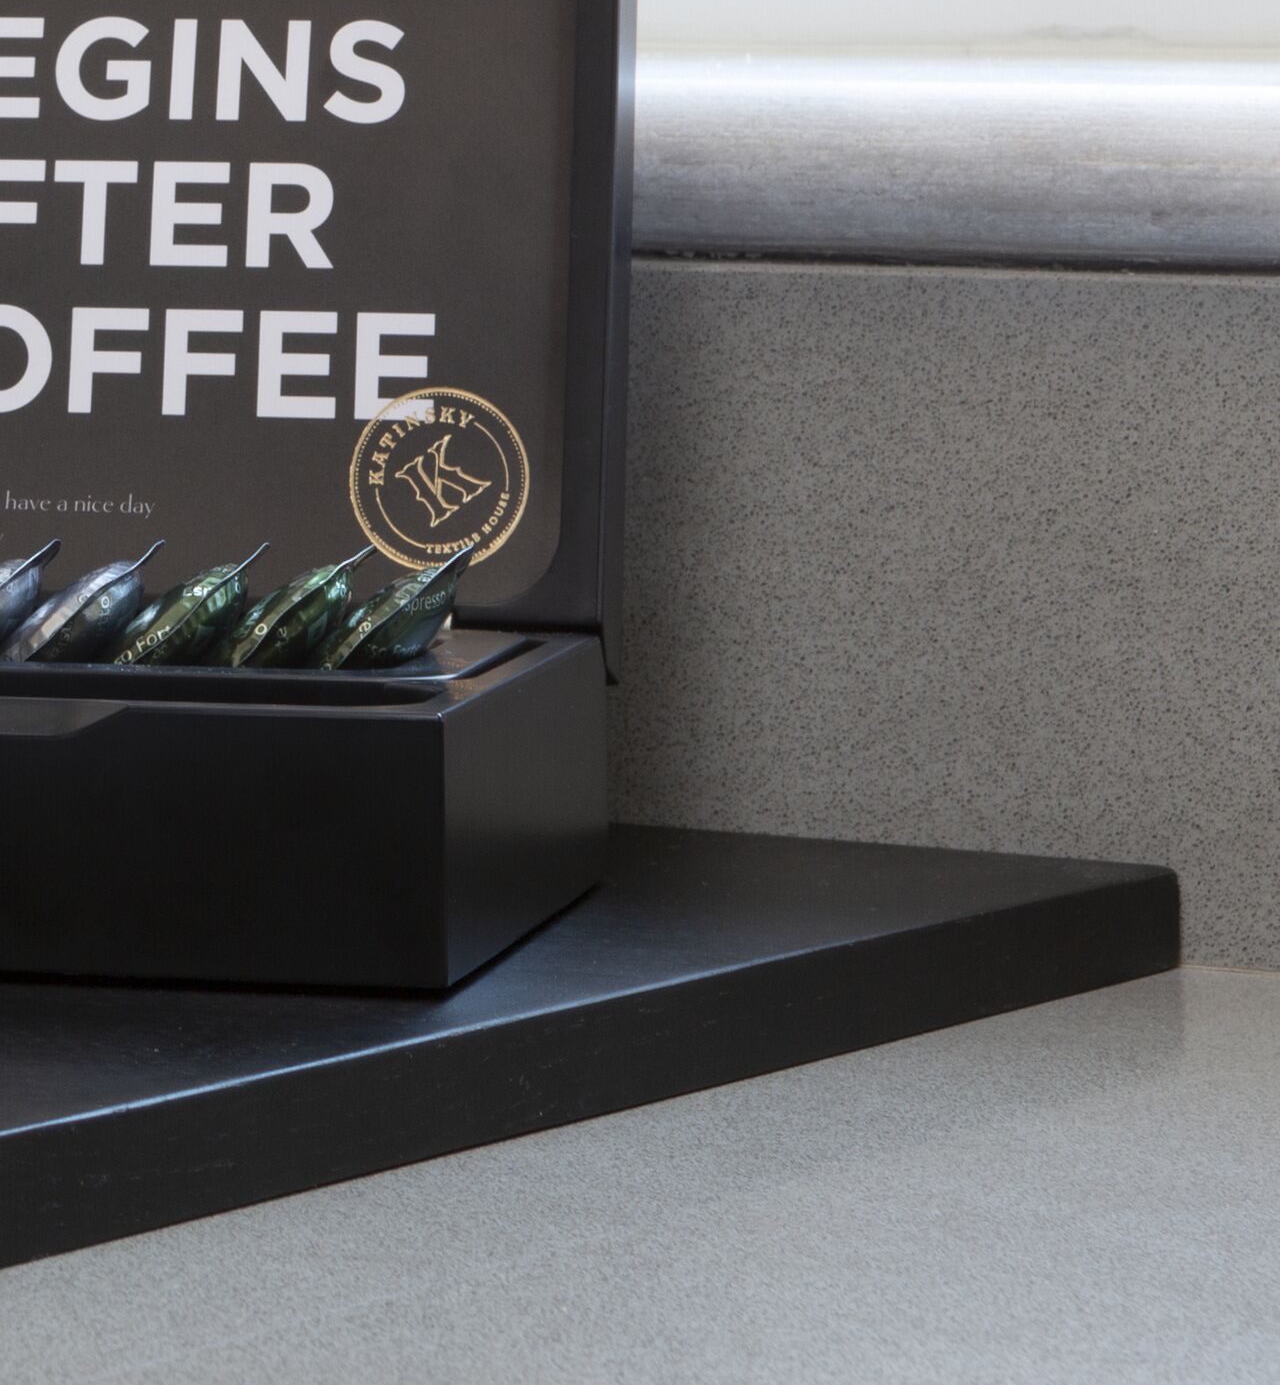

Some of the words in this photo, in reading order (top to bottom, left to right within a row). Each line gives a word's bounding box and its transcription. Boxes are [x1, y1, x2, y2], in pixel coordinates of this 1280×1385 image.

[368, 405, 476, 485] KATINSKY
[5, 489, 51, 512] have
[56, 497, 68, 512] a
[74, 494, 114, 514] nice
[119, 493, 156, 519] day
[481, 491, 510, 535] HOUSE
